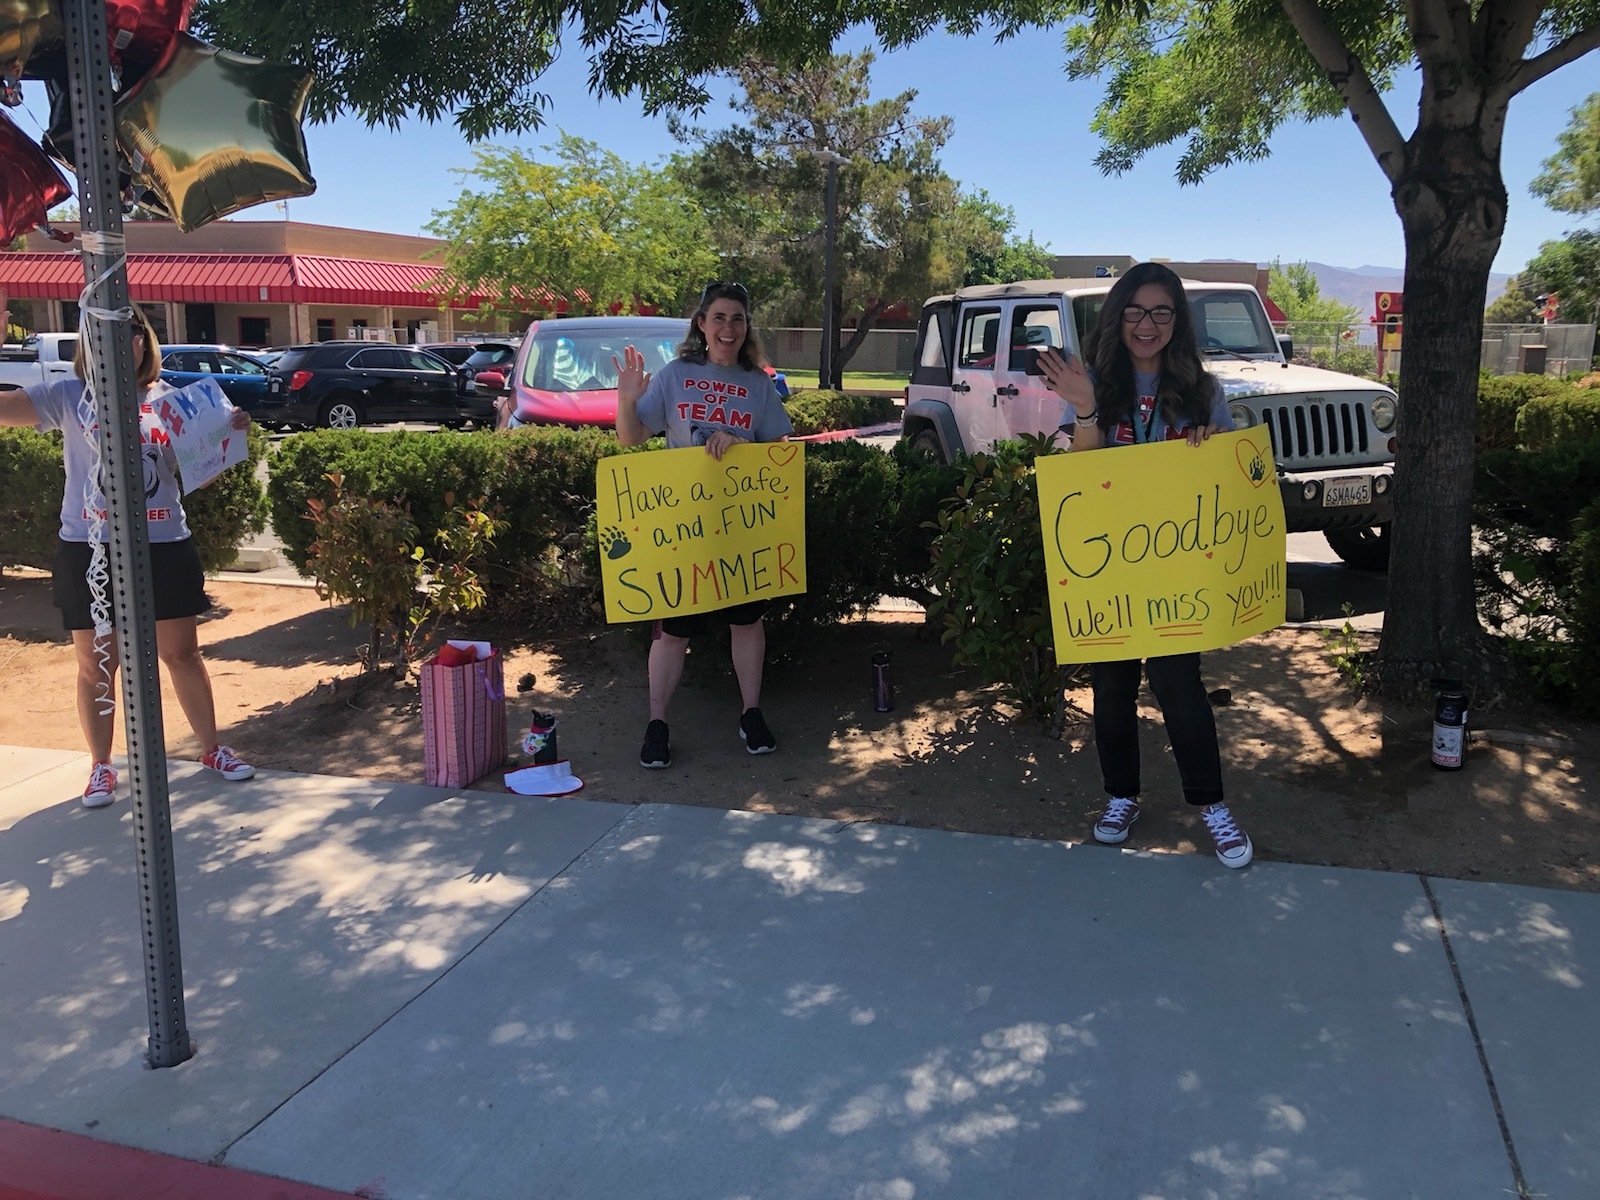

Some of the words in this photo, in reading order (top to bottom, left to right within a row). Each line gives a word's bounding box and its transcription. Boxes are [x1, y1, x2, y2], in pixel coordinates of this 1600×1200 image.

[684, 378, 748, 398] POWER
[703, 393, 728, 405] OF
[677, 402, 752, 431] TEAM
[611, 467, 680, 522] Have
[690, 482, 714, 502] a
[723, 466, 789, 497] Safe
[653, 515, 704, 547] and
[721, 500, 776, 534] FUN
[1055, 484, 1274, 578] Goodbye
[617, 543, 799, 614] SUMMER
[1064, 594, 1133, 638] We'll
[1147, 588, 1210, 625] miss
